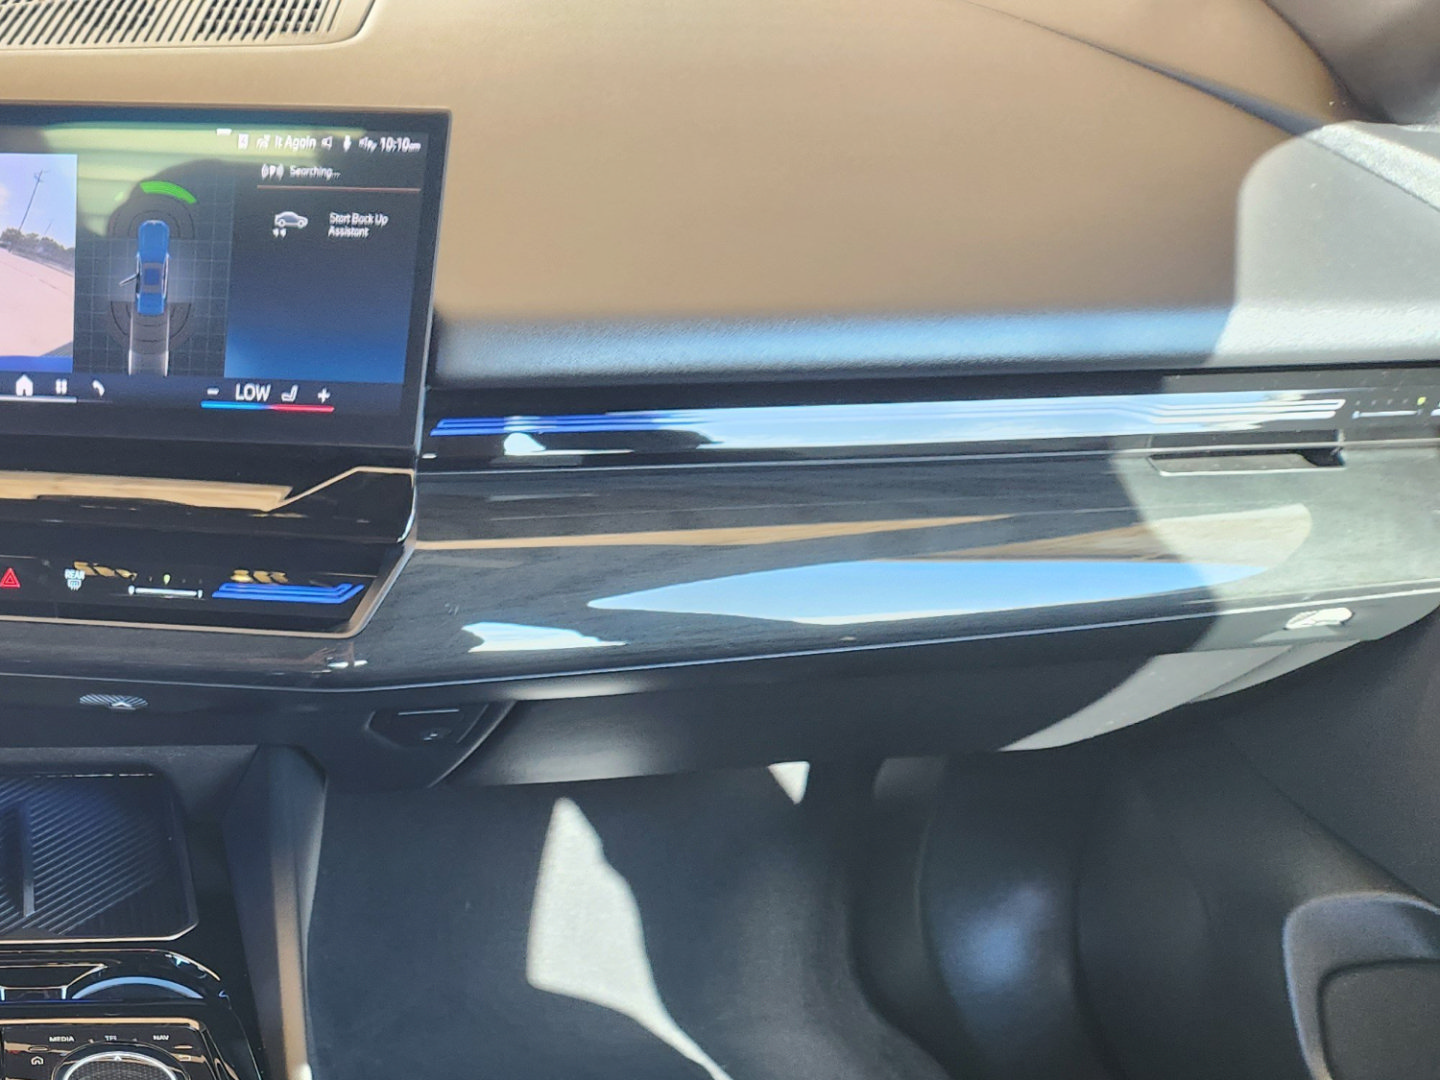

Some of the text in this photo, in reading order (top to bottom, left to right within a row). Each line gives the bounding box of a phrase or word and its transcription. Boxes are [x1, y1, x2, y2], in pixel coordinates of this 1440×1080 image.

[329, 212, 389, 227] Start Back Up
[328, 226, 369, 238] Assistant
[235, 383, 272, 402] LOW
[65, 569, 85, 580] REAR
